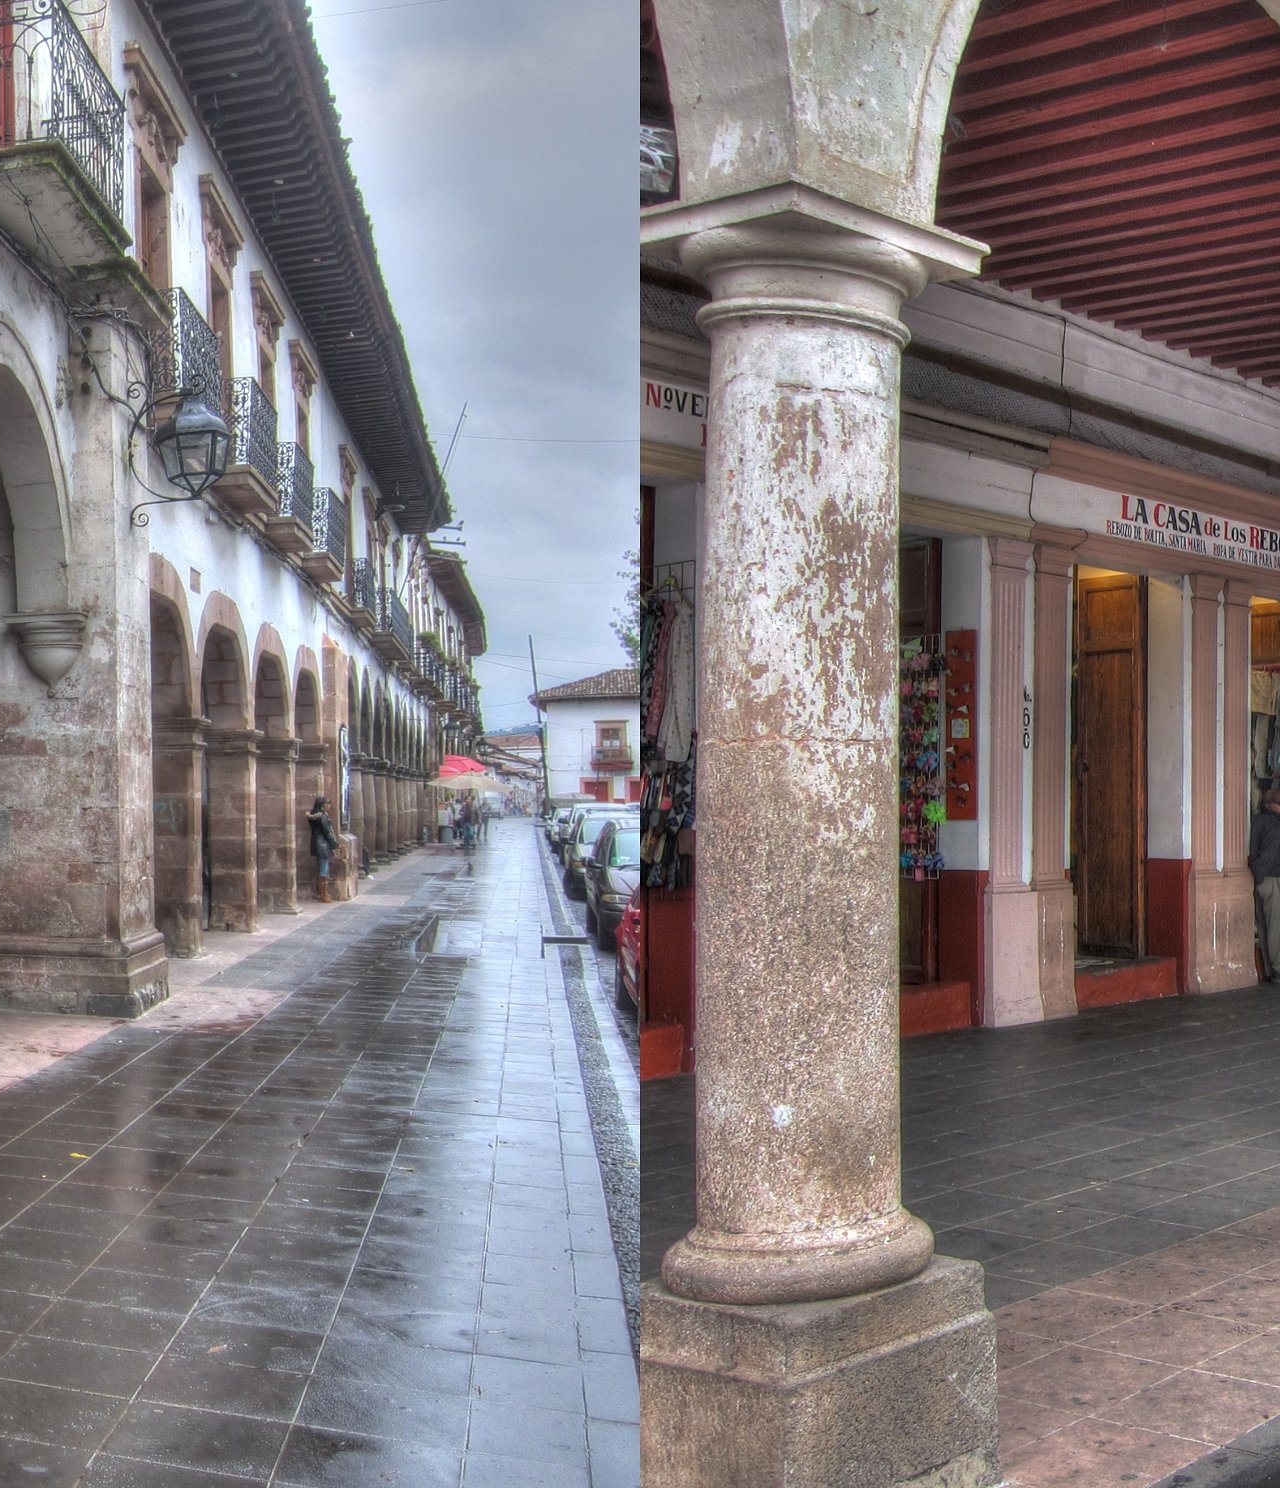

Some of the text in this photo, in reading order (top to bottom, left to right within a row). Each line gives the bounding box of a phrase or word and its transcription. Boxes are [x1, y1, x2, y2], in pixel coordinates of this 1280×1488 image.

[1121, 495, 1149, 525] LA
[1154, 503, 1202, 536] CASA
[1204, 517, 1220, 538] de
[1106, 520, 1132, 538] REBOZO
[1134, 526, 1142, 541] DE
[1168, 533, 1186, 550] SANTA
[1229, 546, 1236, 560] DE
[1238, 548, 1258, 566] VESTIR
[1259, 552, 1273, 568] PARA
